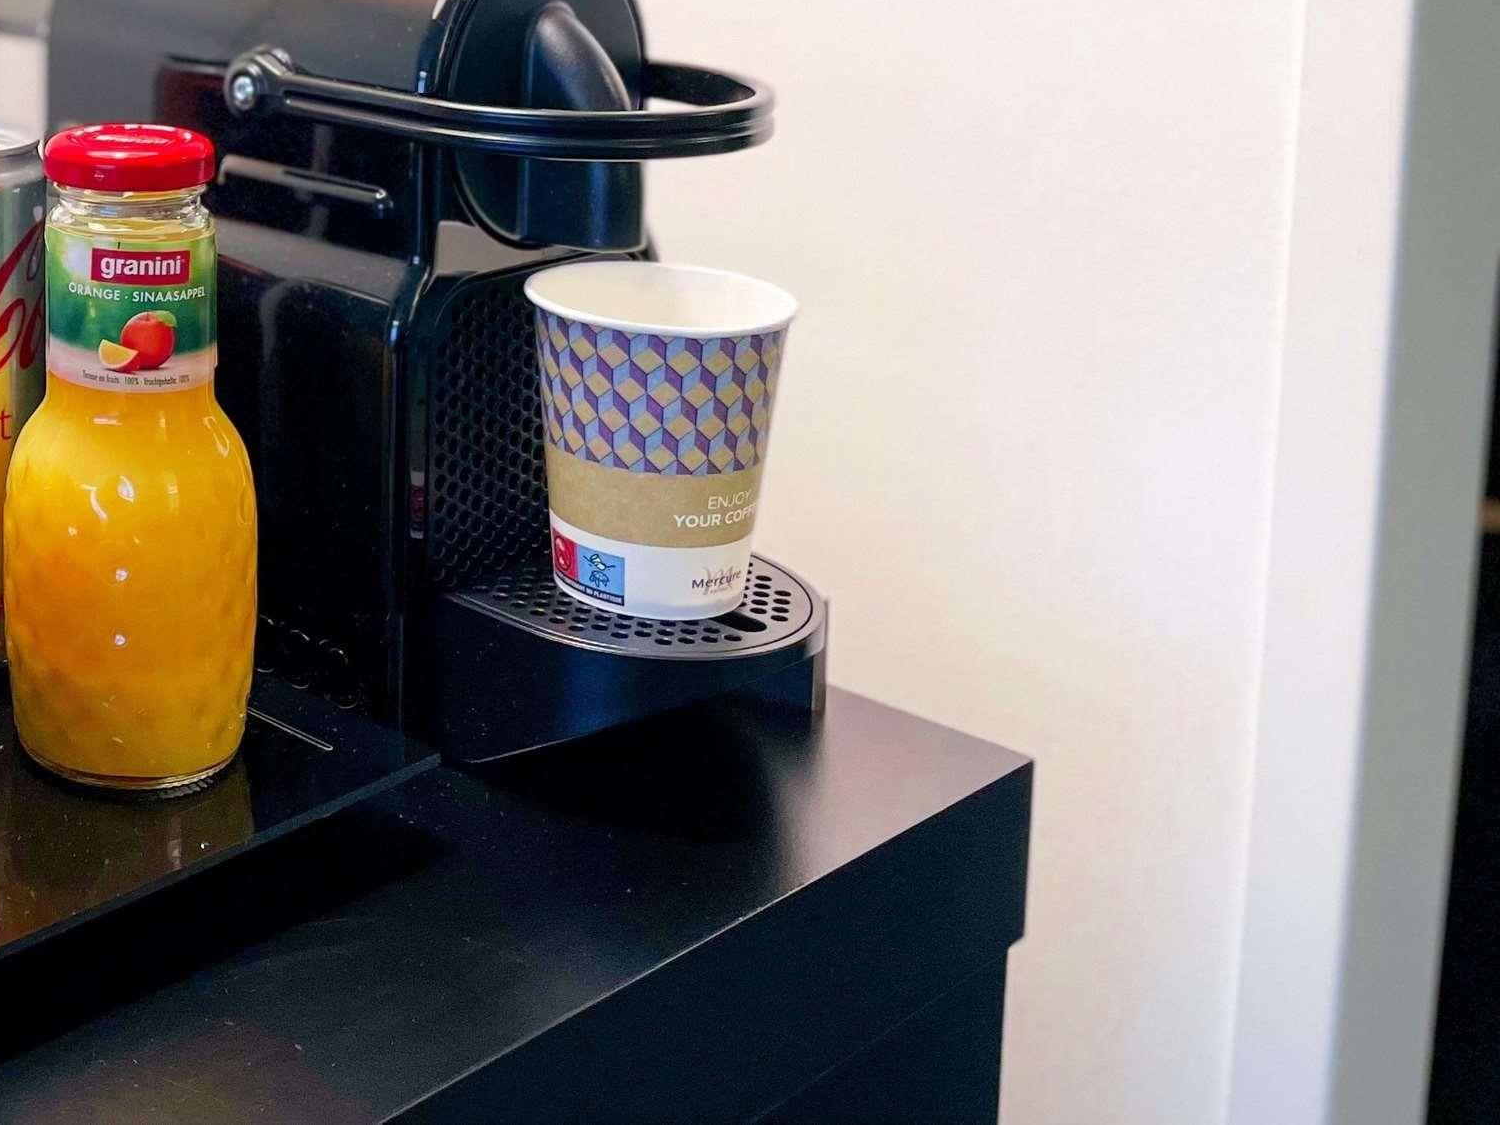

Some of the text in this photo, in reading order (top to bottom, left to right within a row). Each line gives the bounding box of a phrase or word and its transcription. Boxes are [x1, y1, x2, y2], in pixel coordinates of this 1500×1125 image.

[100, 255, 182, 279] granini
[68, 282, 206, 303] ORANGE SINAASAPPEL
[707, 489, 753, 510] ENJOY
[673, 514, 721, 528] YOUR
[691, 570, 742, 589] Mercure
